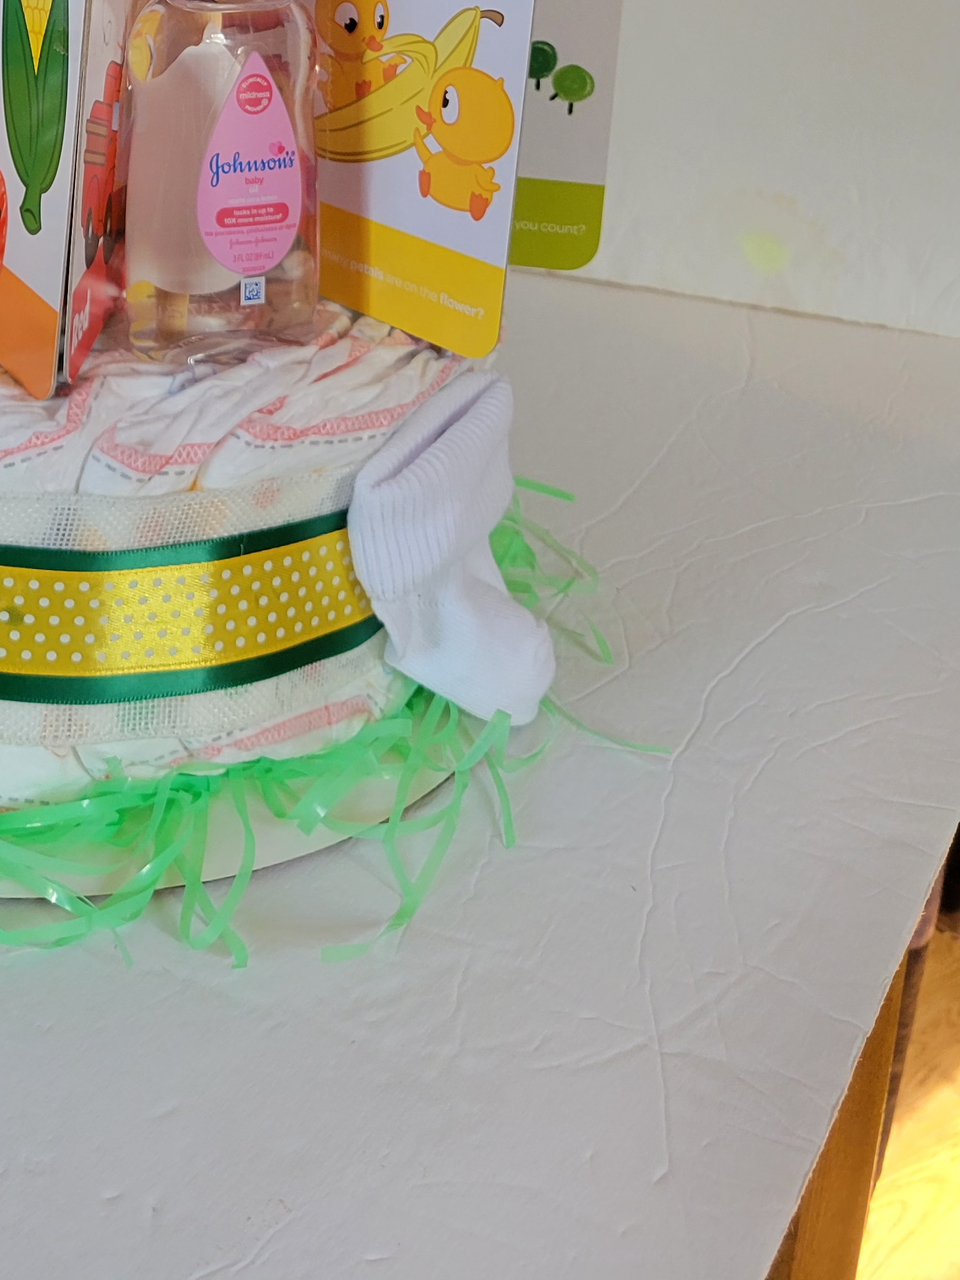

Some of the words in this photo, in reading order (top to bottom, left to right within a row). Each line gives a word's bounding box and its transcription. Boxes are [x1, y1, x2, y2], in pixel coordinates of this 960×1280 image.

[240, 91, 269, 99] mildness
[245, 176, 264, 185] baby
[249, 185, 259, 193] oil
[515, 221, 539, 231] you
[541, 222, 586, 235] count?
[350, 260, 384, 280] petals
[385, 275, 402, 286] are
[404, 281, 418, 294] on
[419, 286, 438, 302] the
[439, 292, 485, 320] flower?
[71, 287, 91, 356] Red
